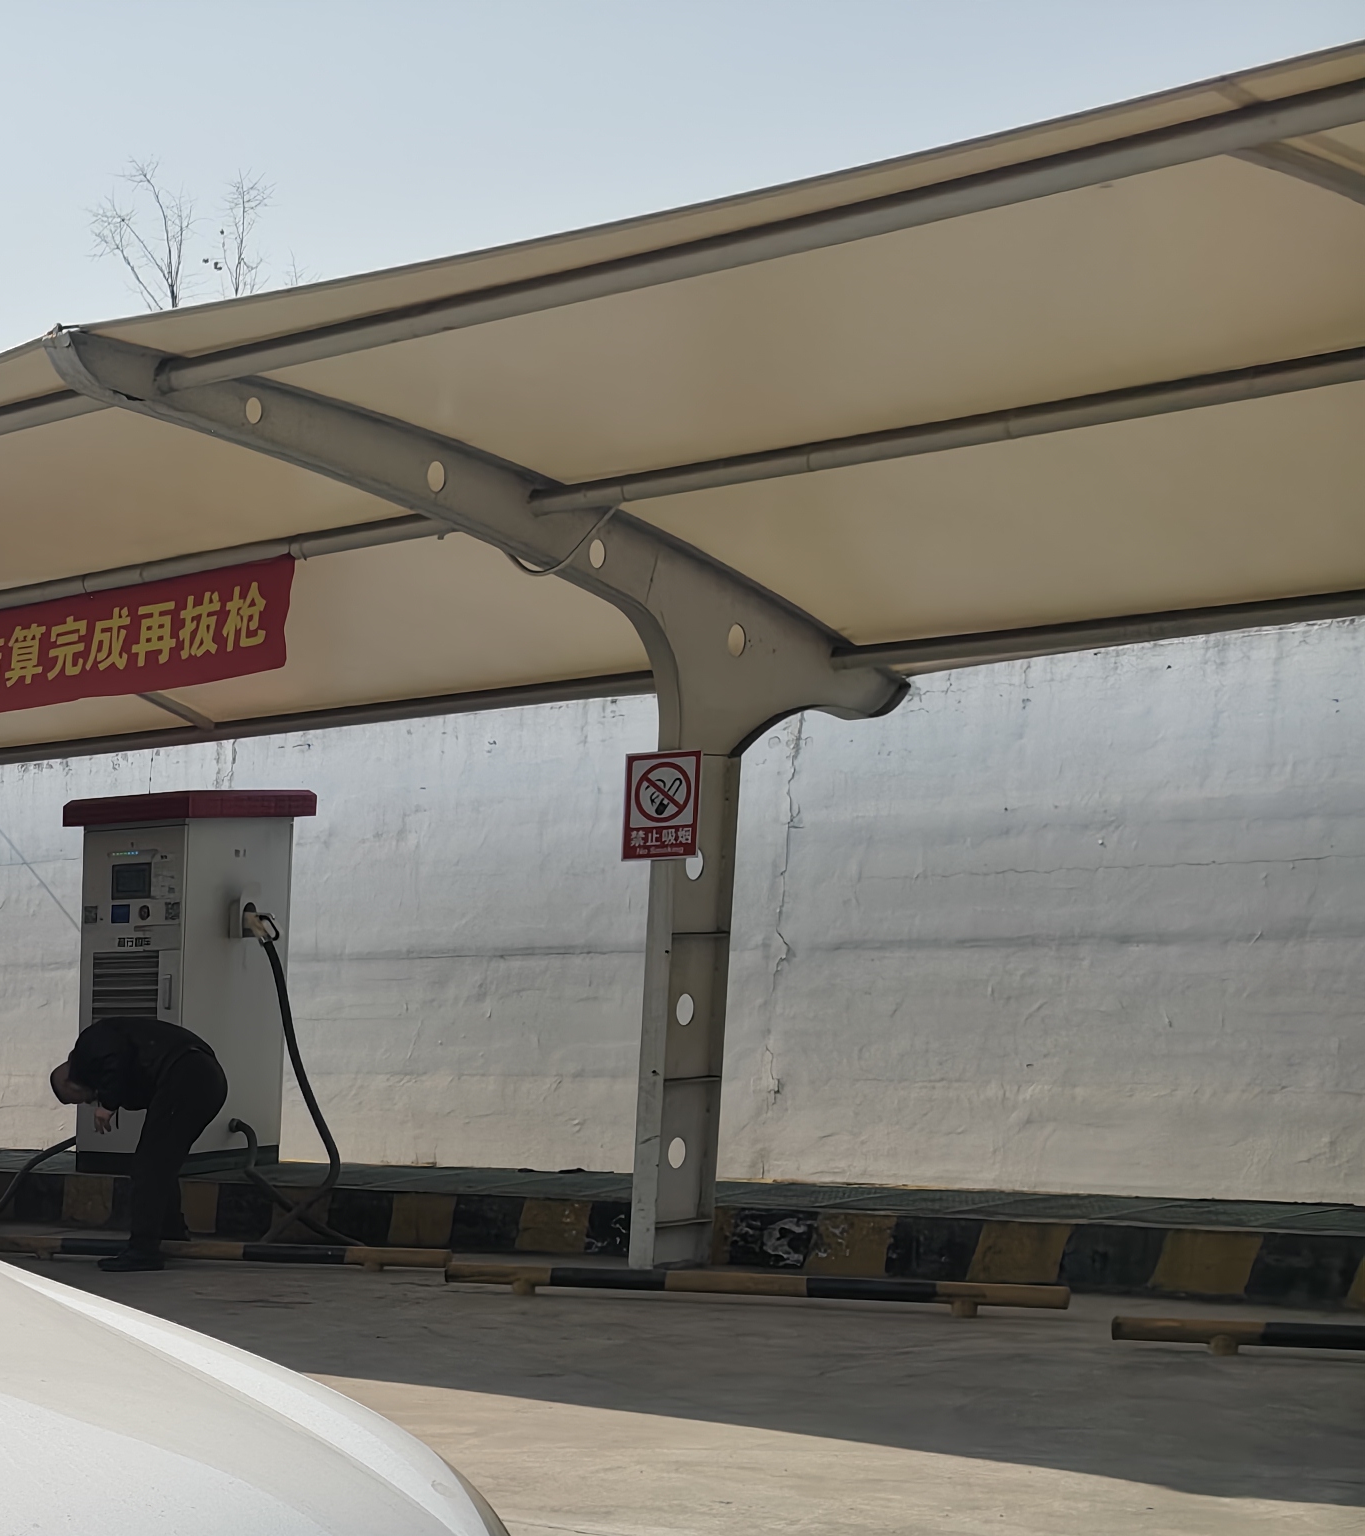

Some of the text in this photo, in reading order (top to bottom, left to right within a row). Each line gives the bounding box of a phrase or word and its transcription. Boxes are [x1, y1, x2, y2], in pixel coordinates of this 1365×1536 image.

[630, 827, 692, 847] 禁止吸烟
[636, 847, 648, 855] No
